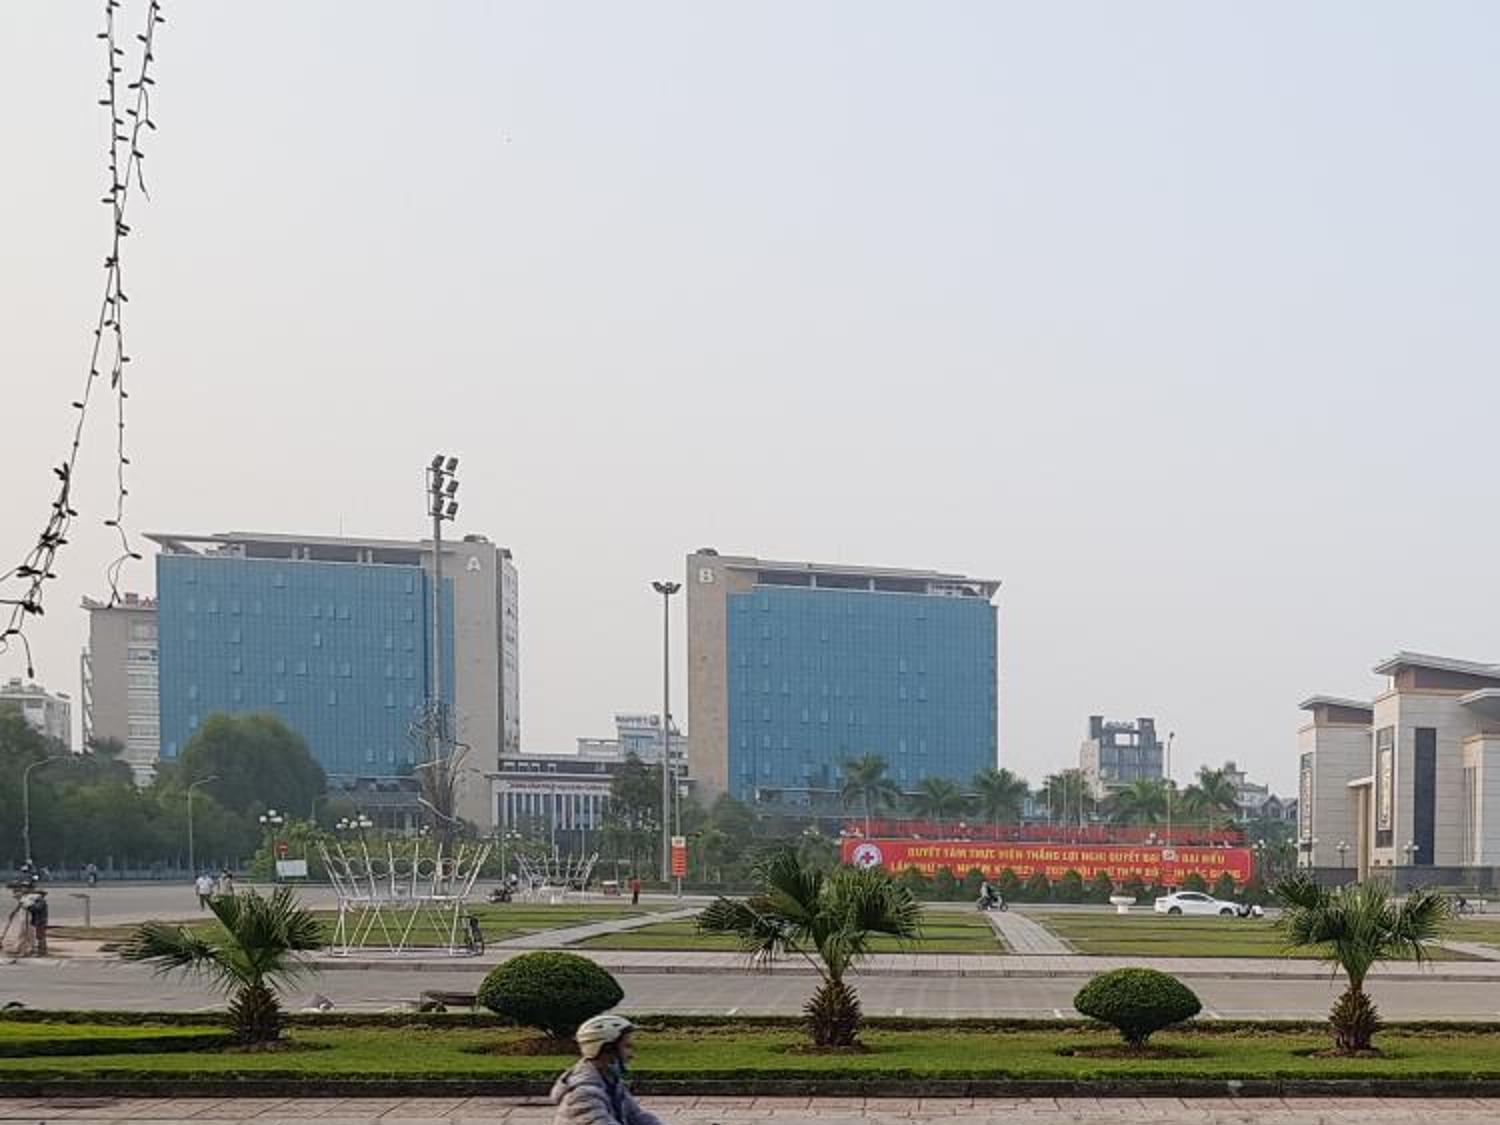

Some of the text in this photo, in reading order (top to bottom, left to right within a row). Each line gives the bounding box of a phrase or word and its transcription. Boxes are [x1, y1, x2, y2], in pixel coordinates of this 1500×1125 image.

[466, 556, 481, 572] A
[699, 567, 713, 583] B
[907, 846, 941, 857] QUYẾT
[944, 848, 967, 858] TÂM
[1026, 848, 1060, 861] THẮNG
[1109, 850, 1140, 863] QUYẾT
